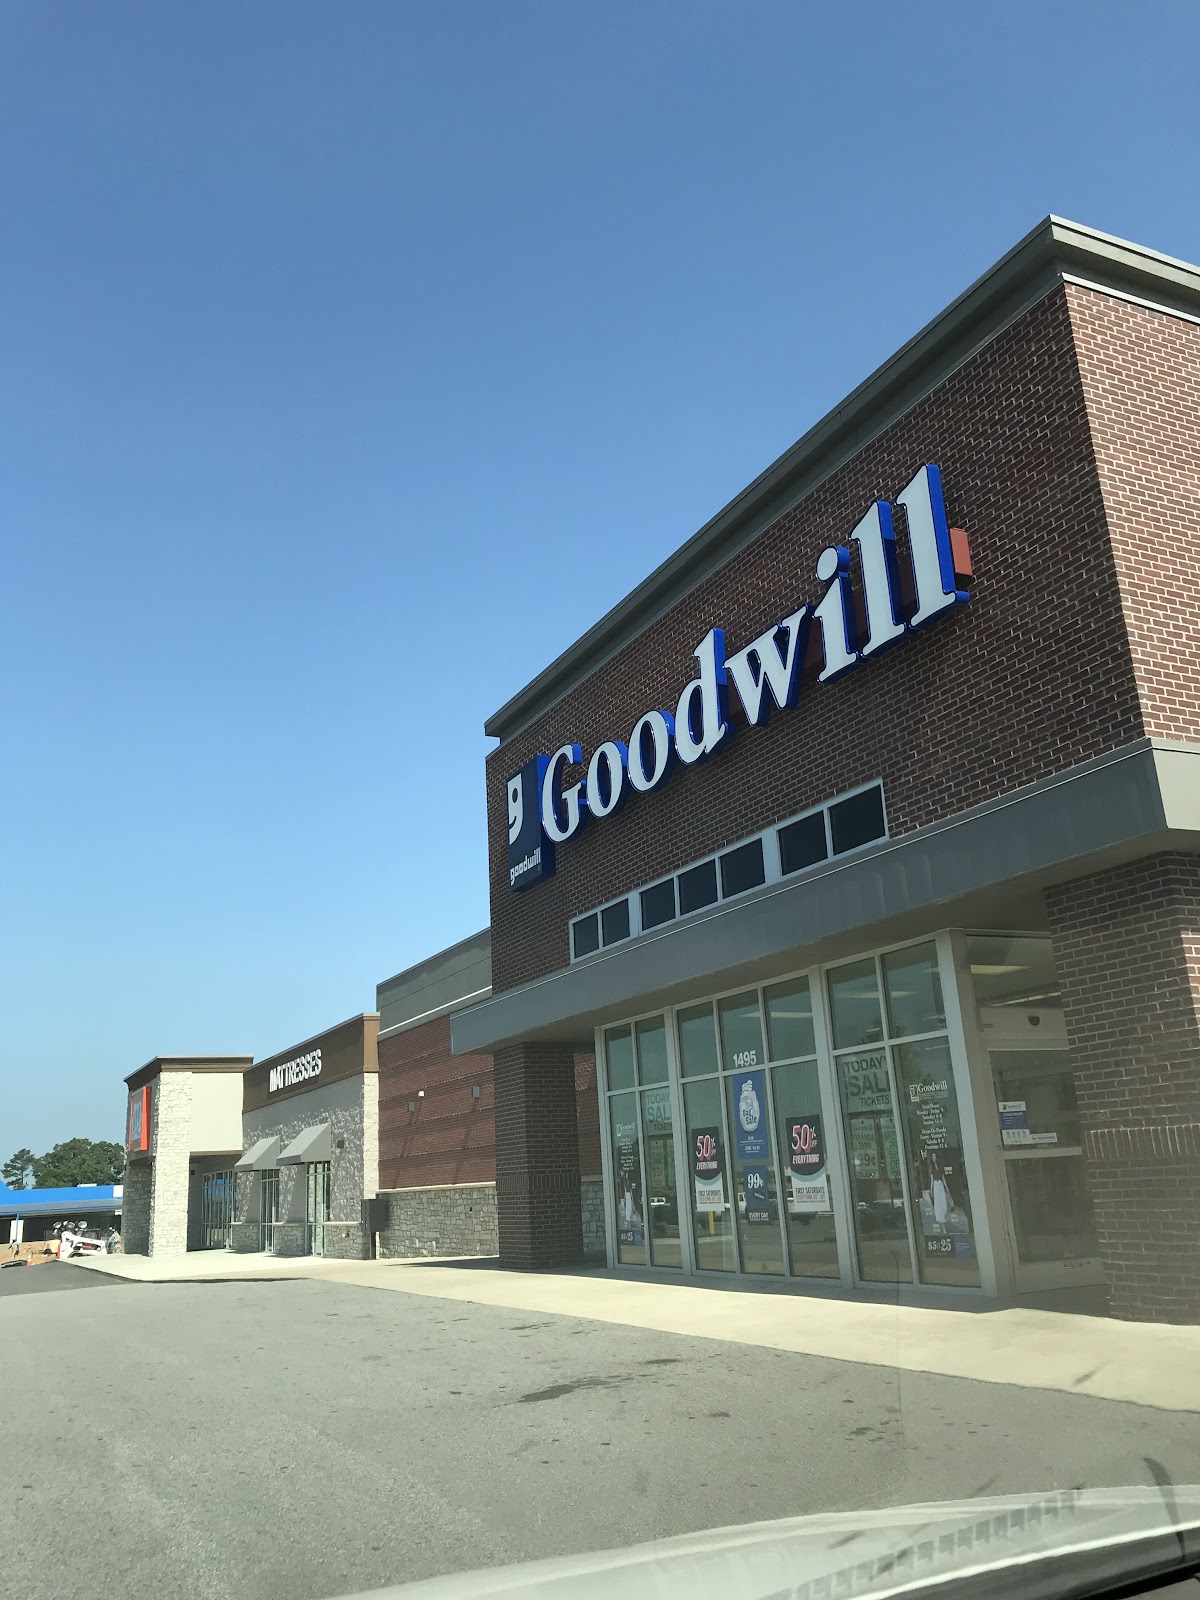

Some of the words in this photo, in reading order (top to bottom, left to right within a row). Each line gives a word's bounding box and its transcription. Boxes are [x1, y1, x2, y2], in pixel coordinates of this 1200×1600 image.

[541, 464, 964, 843] Goodwill
[510, 847, 541, 886] goodwill
[733, 1050, 757, 1067] 1495
[844, 1056, 886, 1073] TODAY'
[269, 1049, 322, 1093] MATTRESSES
[918, 1080, 948, 1092] Goodwill
[860, 1095, 889, 1107] TICKETS
[648, 1105, 671, 1122] SAL
[696, 1134, 715, 1157] 50%
[792, 1124, 816, 1150] 50%
[696, 1161, 718, 1170] EVERYTHING
[793, 1154, 819, 1165] EVERYTHING
[748, 1173, 764, 1189] 99¢
[928, 1240, 937, 1251] $5
[941, 1239, 952, 1251] 25
